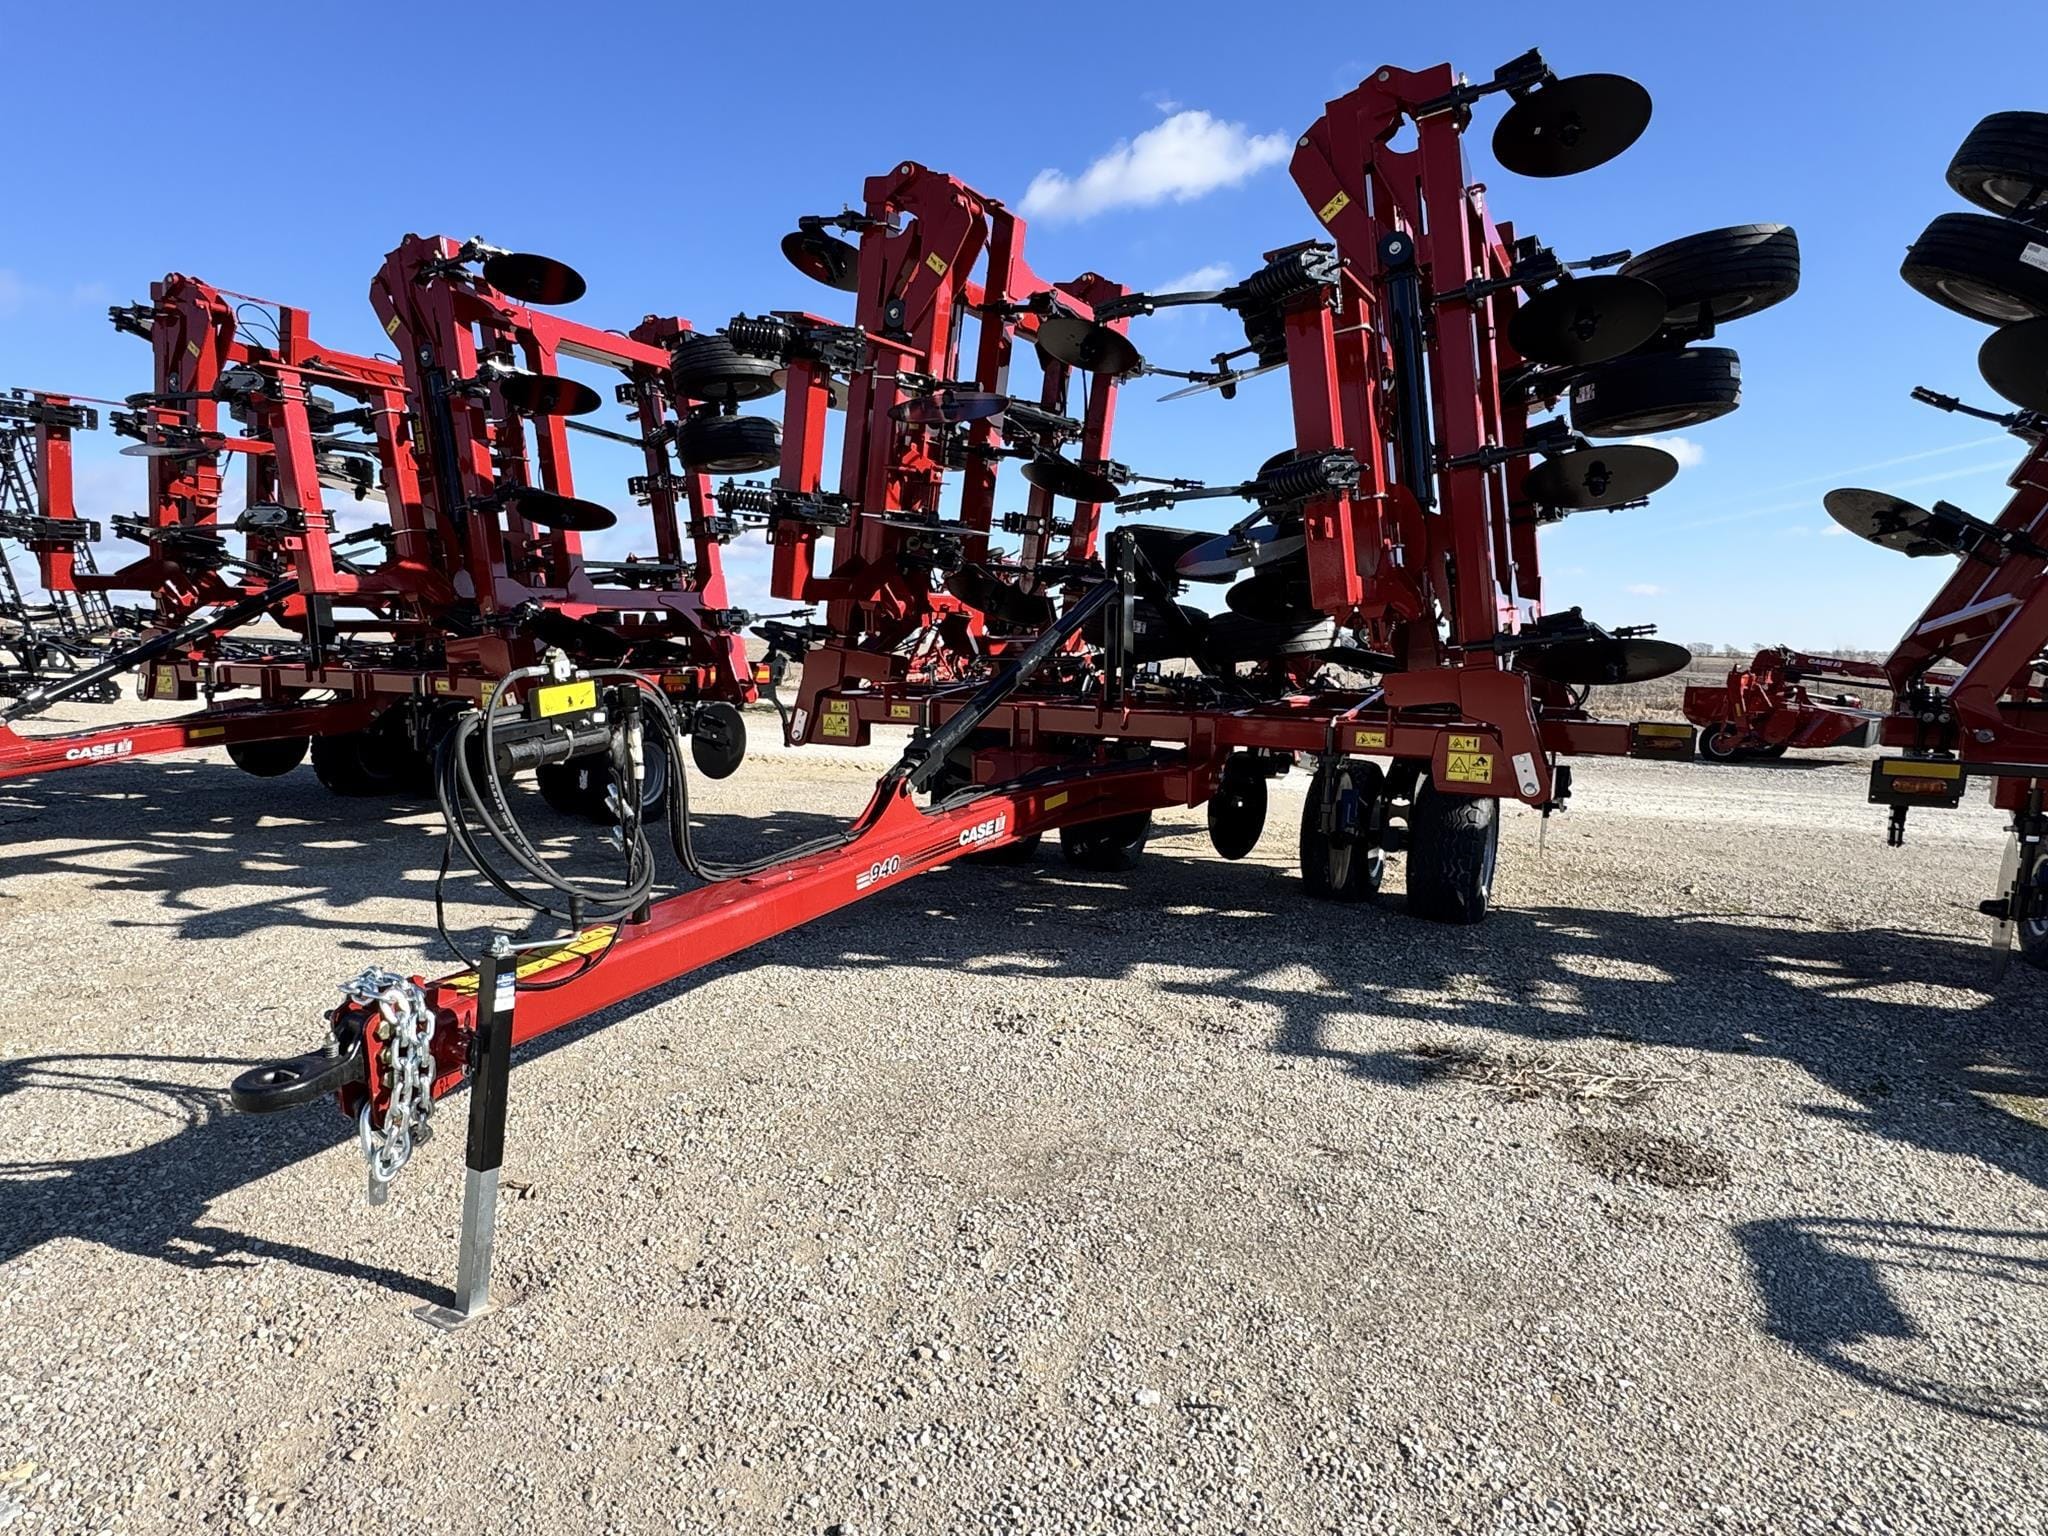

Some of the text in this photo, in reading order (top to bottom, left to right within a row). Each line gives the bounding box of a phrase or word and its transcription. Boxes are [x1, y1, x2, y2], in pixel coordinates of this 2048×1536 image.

[66, 743, 116, 760] CASE
[959, 823, 995, 846] CASE
[870, 854, 900, 883] 940
